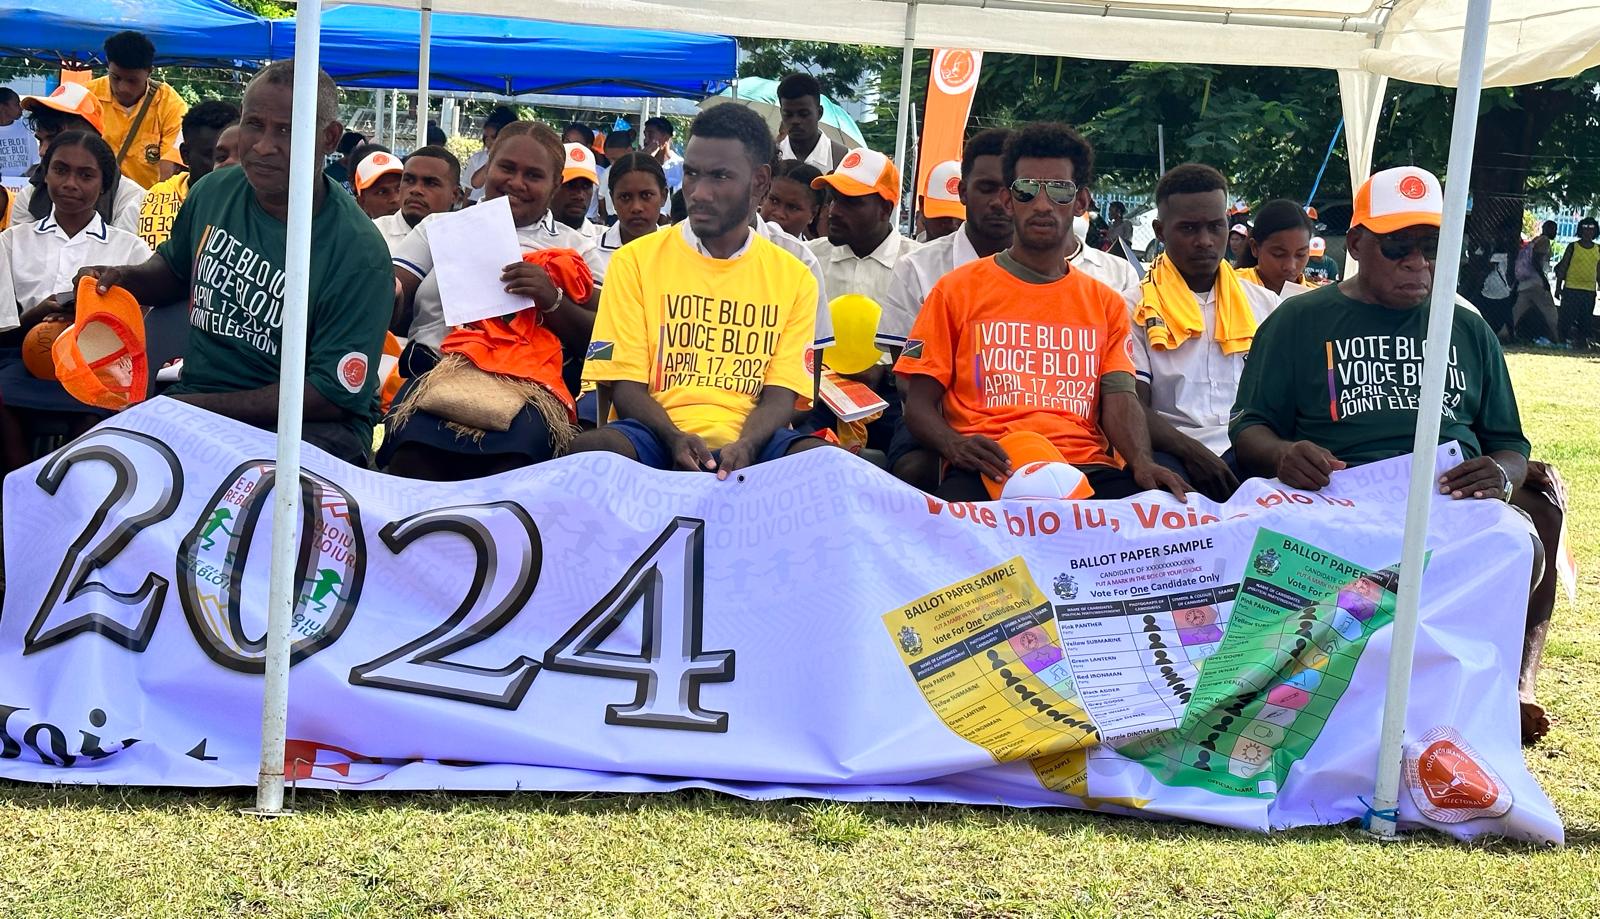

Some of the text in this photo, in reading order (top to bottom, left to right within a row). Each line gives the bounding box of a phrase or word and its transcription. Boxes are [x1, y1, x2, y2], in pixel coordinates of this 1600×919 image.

[205, 225, 286, 299] VOTE BLO IU
[193, 285, 214, 311] APRIL
[198, 254, 284, 328] VOICE BLO IU
[667, 294, 778, 328] VOTE BLO IU
[212, 313, 278, 356] ELECTION
[667, 322, 781, 356] VOICE BLO IU
[981, 322, 1096, 352] VOTE BLO IU
[1335, 336, 1390, 360] VOTE
[664, 352, 701, 374] APRIL
[707, 357, 727, 377] 17,
[981, 347, 1100, 378] VOICE BLO IU
[985, 373, 1095, 400] APRIL 17, 2024
[1338, 361, 1398, 385] VOICE
[1449, 367, 1467, 390] IU
[1340, 385, 1388, 403] APRIL
[1340, 395, 1383, 419] JOINT
[926, 498, 997, 529] Vote
[1004, 508, 1061, 538] blo
[1256, 489, 1313, 508] blo
[1070, 537, 1214, 570] BALLOT PAPER SAMPLE
[1283, 539, 1329, 565] BALLOT
[23, 427, 735, 733] 2024
[1100, 565, 1145, 579] CANDIDATE OF
[1112, 576, 1129, 585] MARK
[1136, 574, 1147, 582] THE
[1147, 572, 1158, 580] BOX
[1166, 569, 1183, 577] YOUR
[1183, 565, 1202, 575] CHOICE
[1305, 565, 1337, 583] CANDIDATE
[904, 593, 944, 620] BALLOT
[945, 581, 975, 601] PAPER
[974, 564, 1017, 592] SAMPLE
[1090, 573, 1220, 598] Vote For One Candidate Only
[1218, 587, 1235, 595] MARK
[1287, 576, 1306, 592] Vote
[1308, 585, 1323, 597] For
[934, 602, 965, 622] CANDIDATE
[1233, 615, 1254, 626] Yellow
[1253, 601, 1281, 616] PANTHER
[932, 632, 951, 645] Vote
[951, 625, 965, 638] For
[965, 616, 984, 632] One
[982, 604, 1015, 622] Candidate
[1014, 598, 1031, 611] Only
[1086, 637, 1121, 645] SUBMARINE
[933, 671, 956, 685] PANTHER
[1090, 671, 1122, 679] IRONMAN
[951, 683, 980, 701] SUBMARINE
[964, 704, 987, 719] LANTERN
[974, 718, 1002, 734] IRONMAN
[1106, 727, 1160, 741] Purple DINOSAUR
[1040, 766, 1054, 777] Pine
[1207, 778, 1254, 793] OFFICIAL MARK
